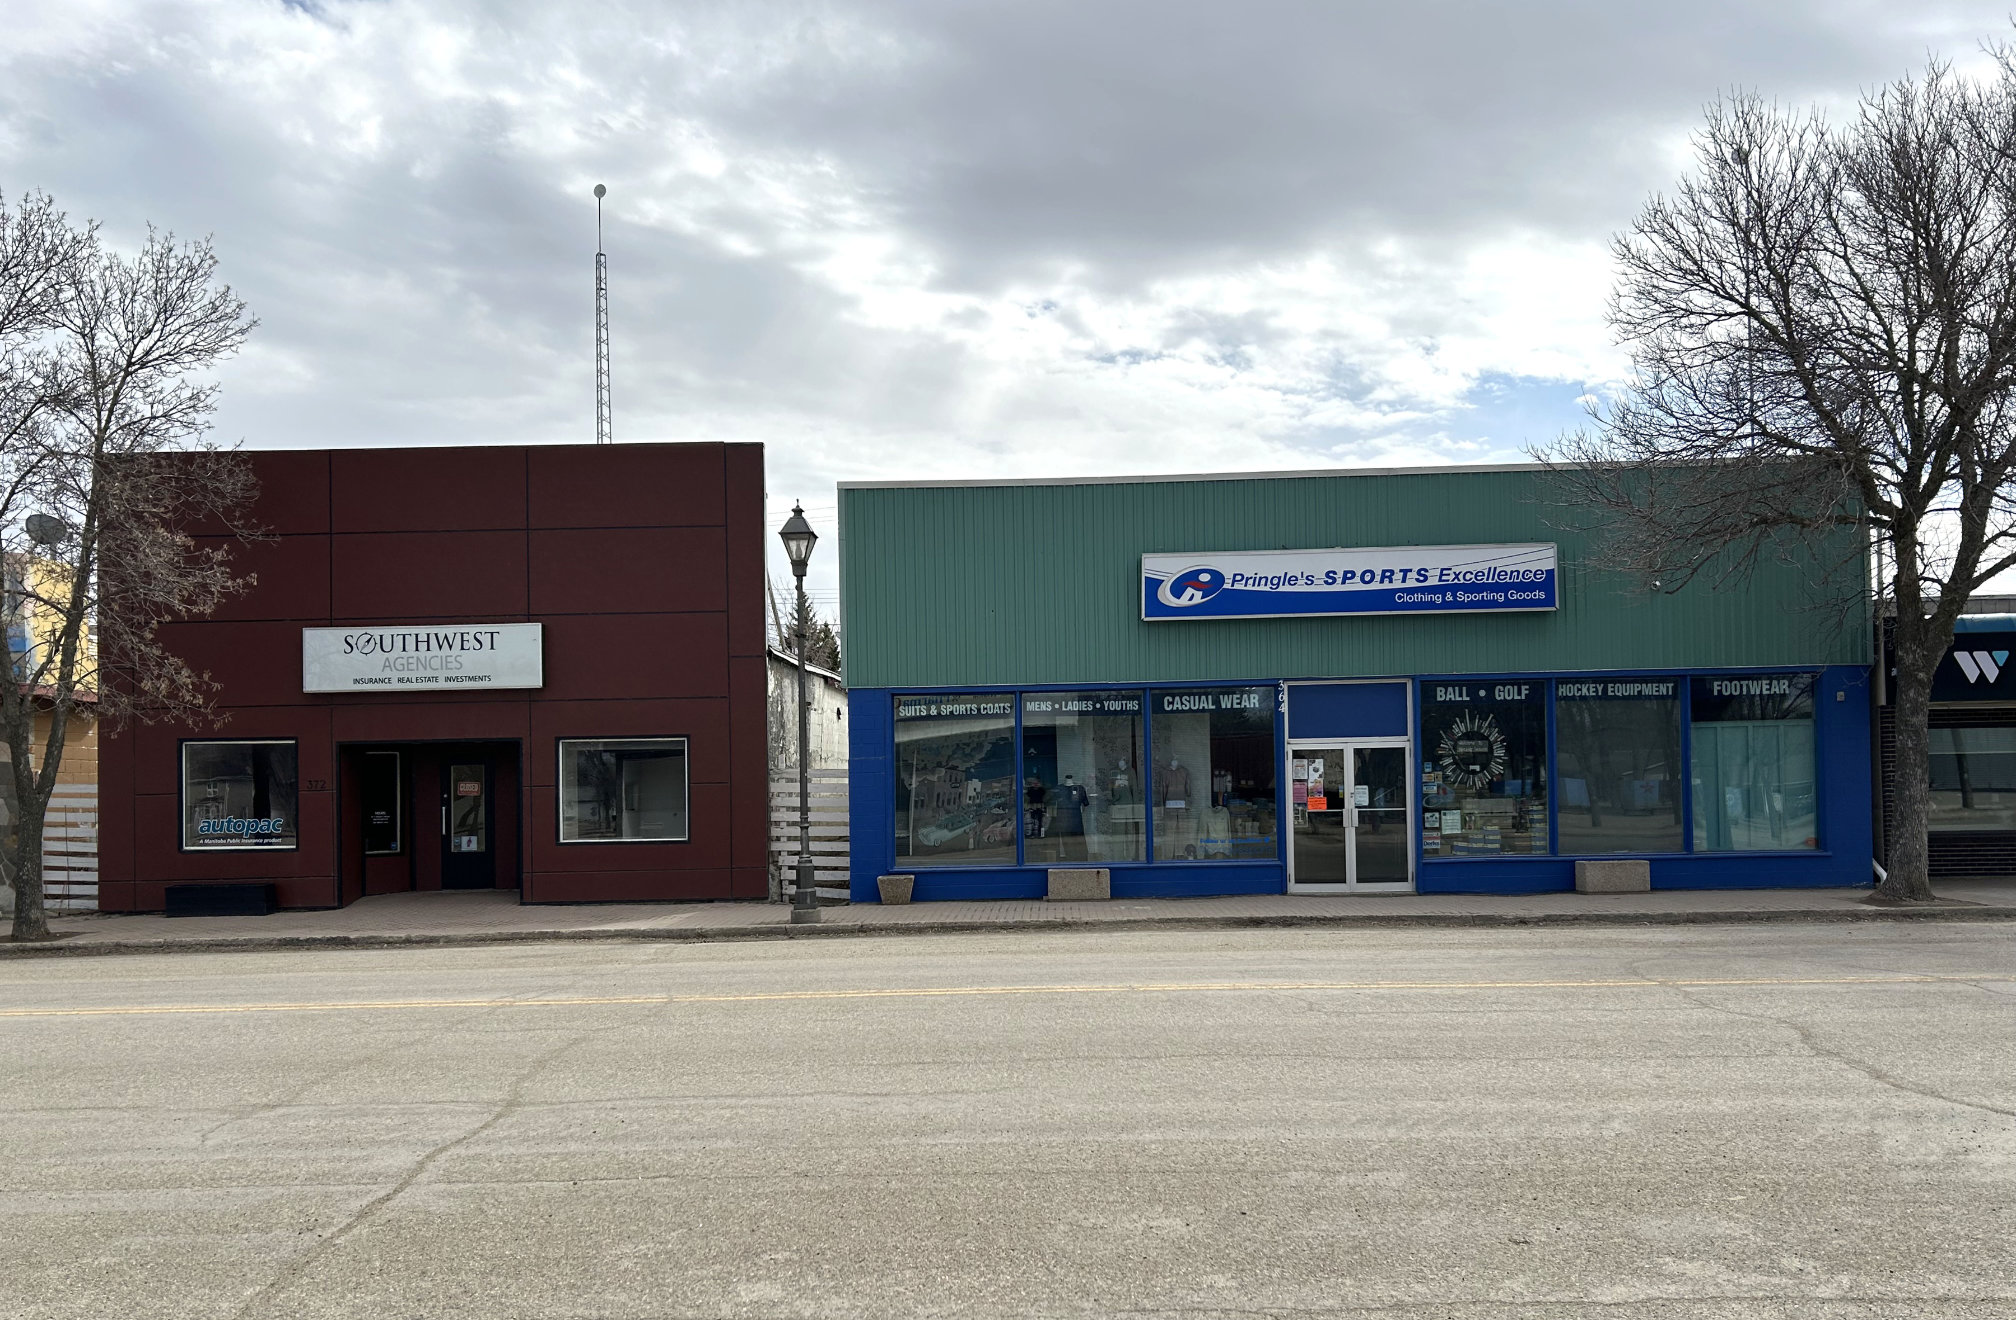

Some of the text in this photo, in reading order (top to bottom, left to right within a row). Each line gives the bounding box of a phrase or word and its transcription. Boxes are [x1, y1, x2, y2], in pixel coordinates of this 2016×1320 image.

[1230, 566, 1546, 590] Pringle's SPORTS Excellence
[1395, 589, 1546, 604] Clothing & Sporting Goods
[343, 630, 500, 656] SOUTHWEST
[381, 655, 463, 673] AGENCIES
[353, 675, 492, 685] INSURANCE REAL ESTATE INVESTMENTS
[1713, 679, 1789, 696] FOOTWEAR
[1436, 685, 1530, 701] BALL GOLF
[1558, 682, 1675, 697] HOCKEY EQUIPMENT
[1026, 700, 1139, 712] MENS LADIES YOUTHS
[1163, 693, 1259, 711] CASUAL WEAR
[898, 703, 1011, 717] SUITS & SPORTS COATS
[306, 780, 327, 790] 372
[460, 783, 479, 792] CLOSED
[199, 815, 283, 838] autopac
